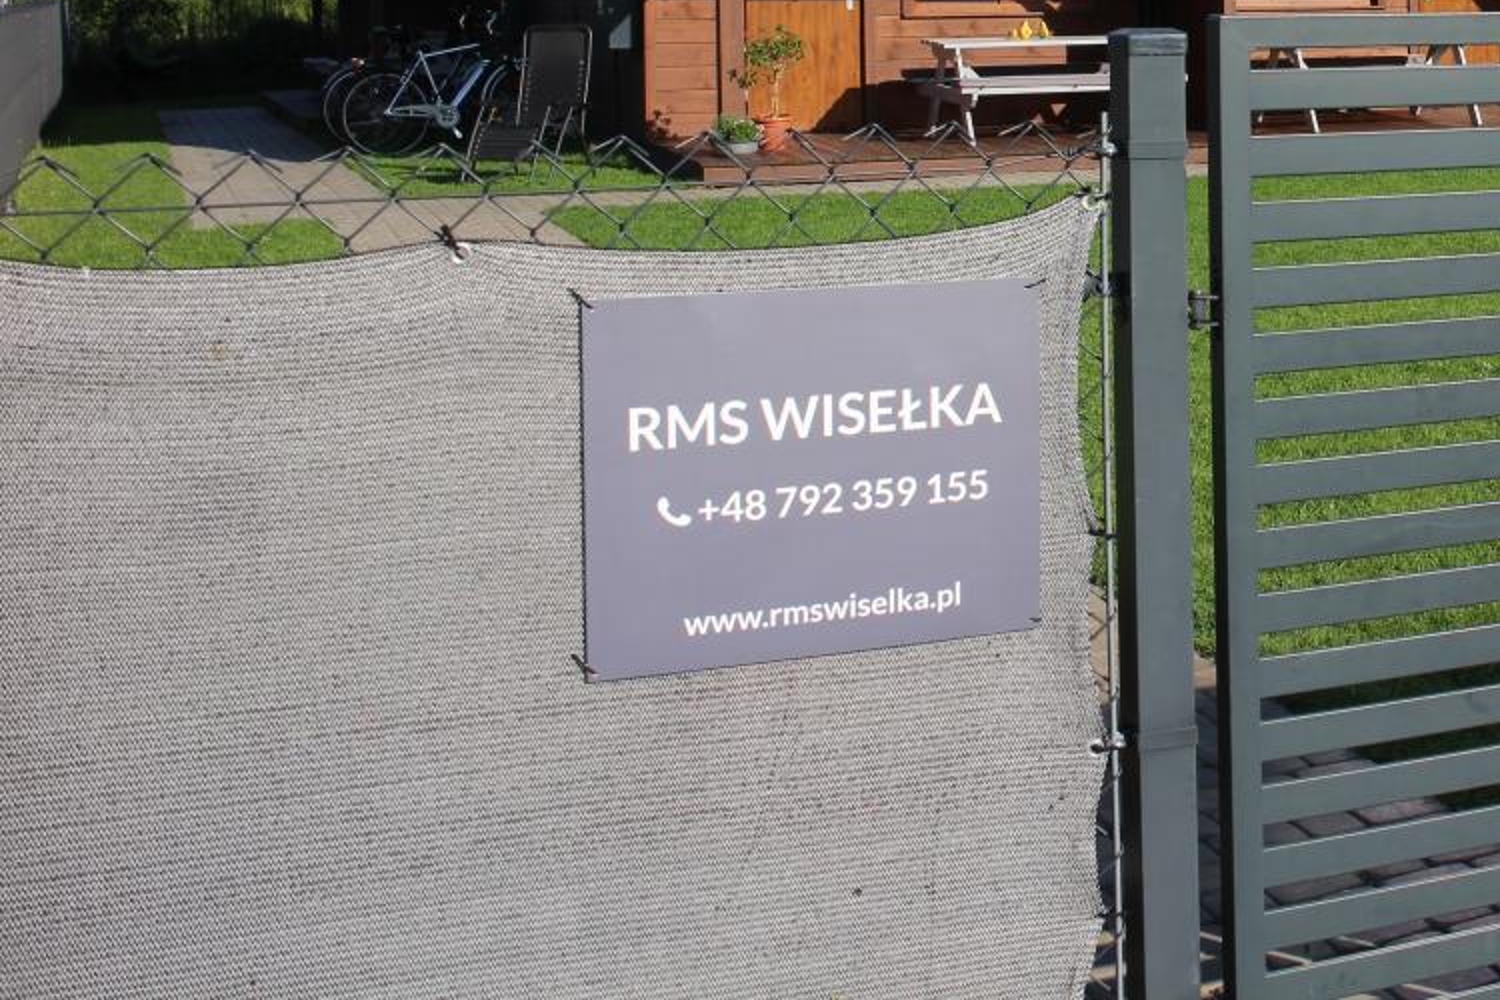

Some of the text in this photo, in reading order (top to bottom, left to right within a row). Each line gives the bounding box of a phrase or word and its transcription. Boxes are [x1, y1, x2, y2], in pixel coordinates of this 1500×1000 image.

[627, 382, 1002, 452] RMS WISEŁKA
[698, 470, 988, 523] +48 792 359 155
[684, 580, 962, 637] www.rmswiselka.pl
